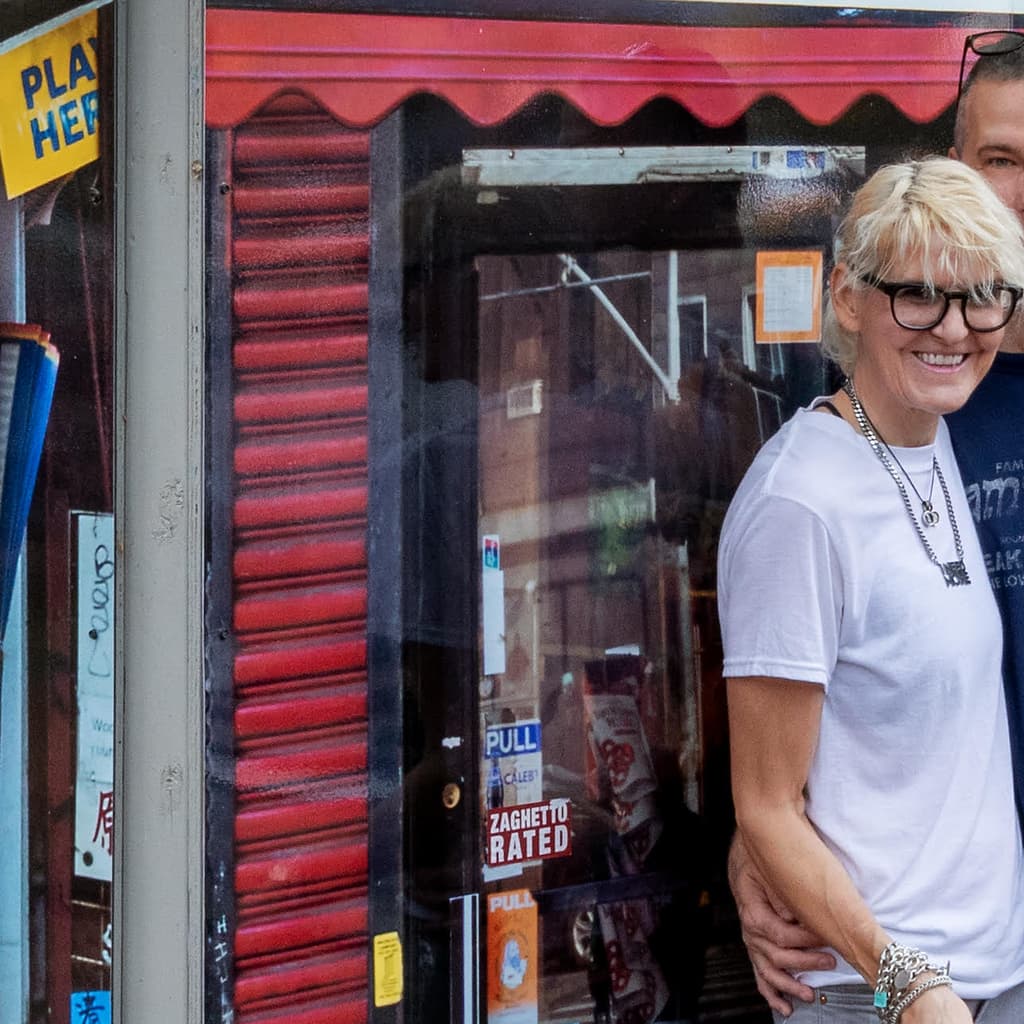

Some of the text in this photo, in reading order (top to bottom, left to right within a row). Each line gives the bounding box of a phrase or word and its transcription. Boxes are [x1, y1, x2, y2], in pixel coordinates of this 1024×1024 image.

[487, 726, 537, 755] PULL
[490, 802, 568, 833] ZAGHETTO
[490, 824, 569, 864] RATED
[490, 892, 534, 913] PULL
